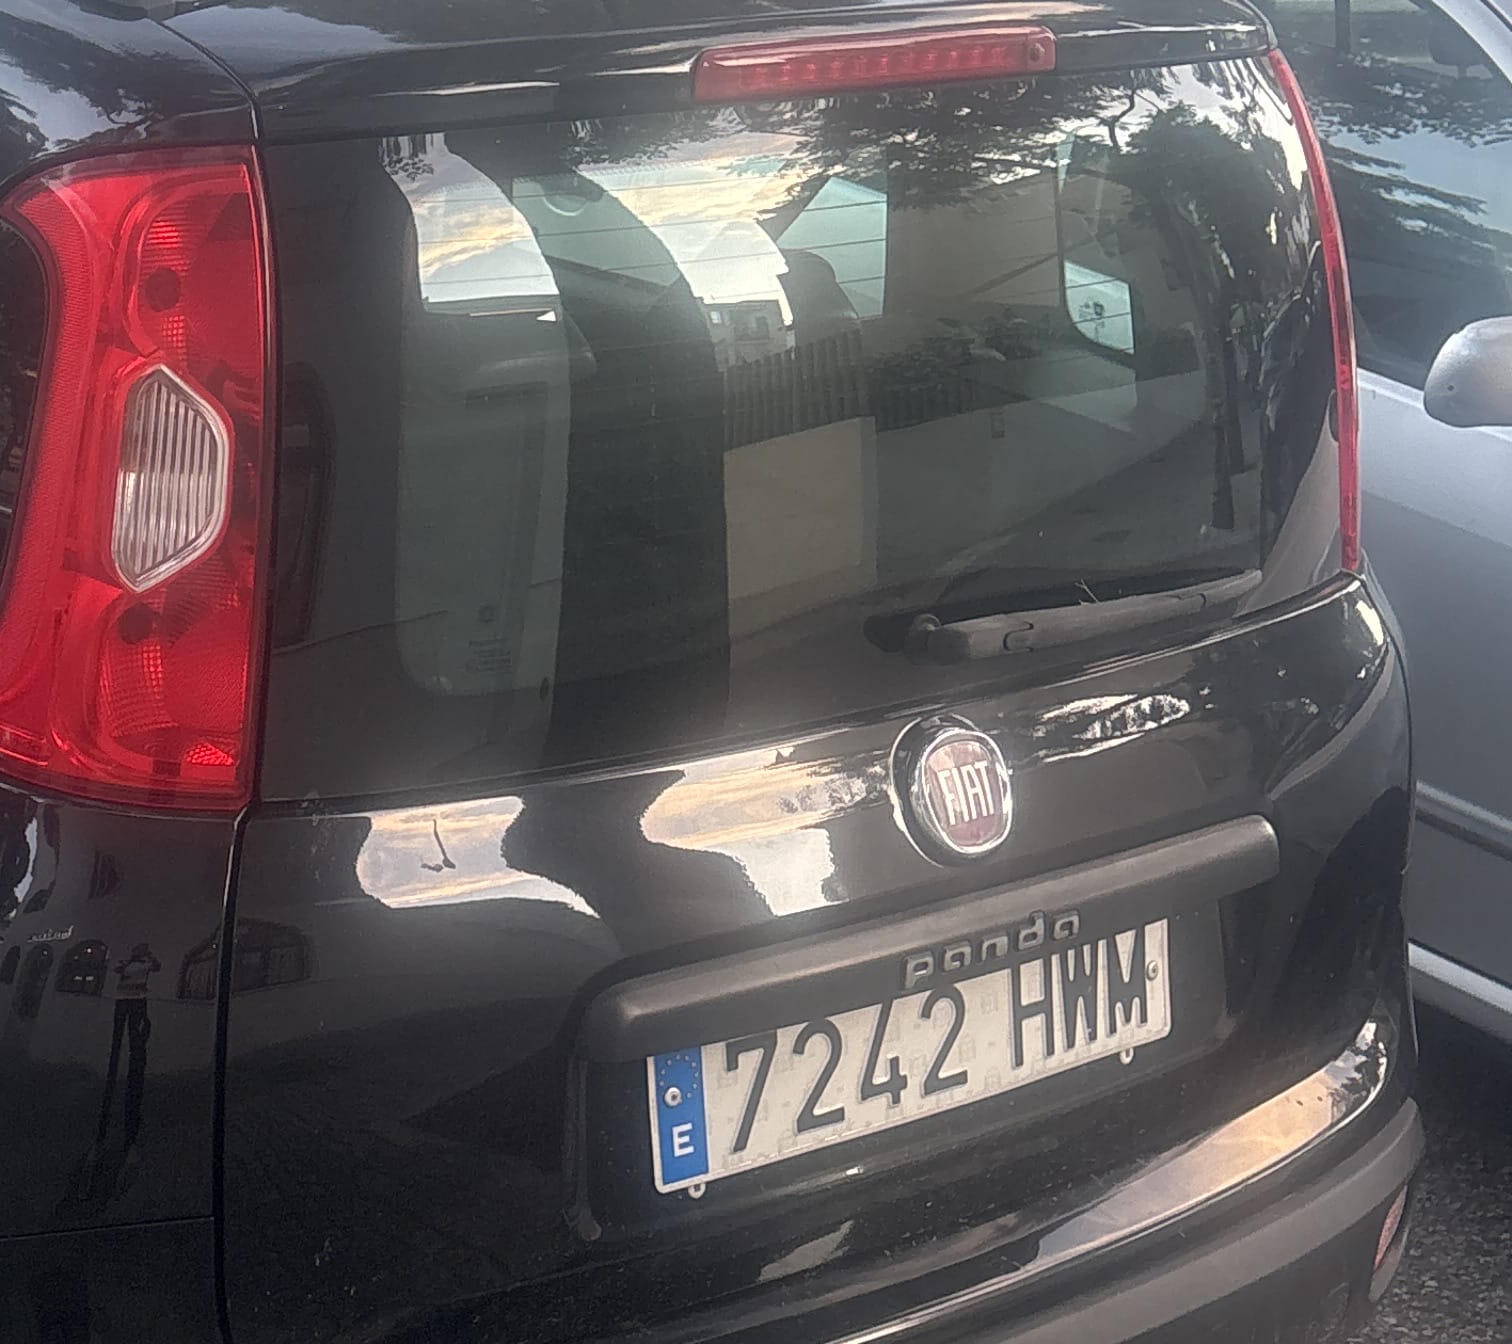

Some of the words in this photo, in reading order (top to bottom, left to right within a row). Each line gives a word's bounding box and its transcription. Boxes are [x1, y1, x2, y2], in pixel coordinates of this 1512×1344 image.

[937, 759, 996, 827] FIAT
[671, 1122, 696, 1158] E
[724, 984, 970, 1155] 7242
[1006, 922, 1150, 1071] HWM
